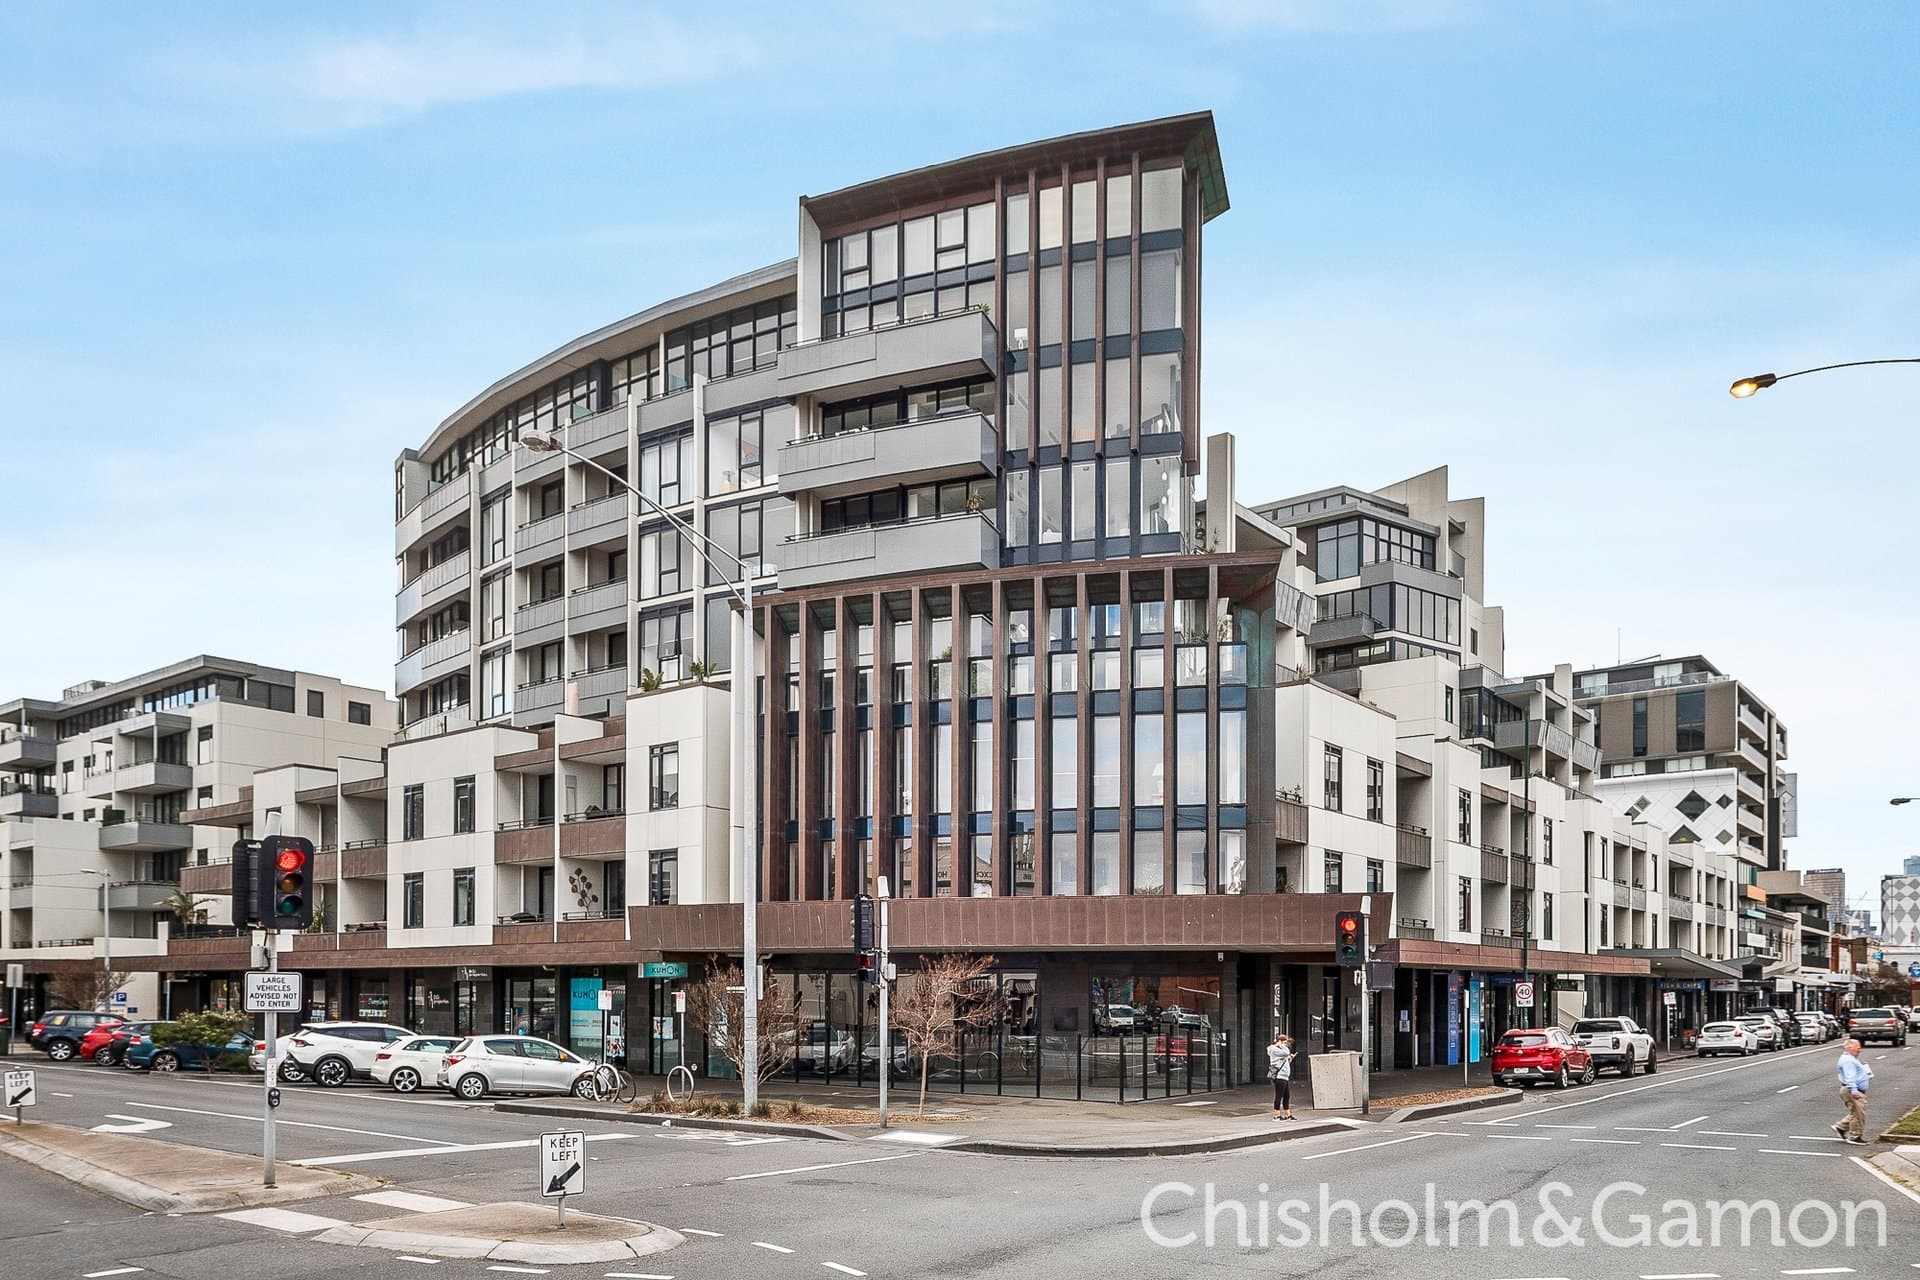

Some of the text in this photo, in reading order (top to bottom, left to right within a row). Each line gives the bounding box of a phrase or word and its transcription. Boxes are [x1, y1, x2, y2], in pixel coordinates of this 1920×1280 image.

[651, 965, 680, 974] KUMON
[573, 989, 598, 1000] KUMO
[1519, 988, 1530, 996] 40
[550, 1138, 578, 1148] KEEP
[552, 1151, 577, 1161] LEFT
